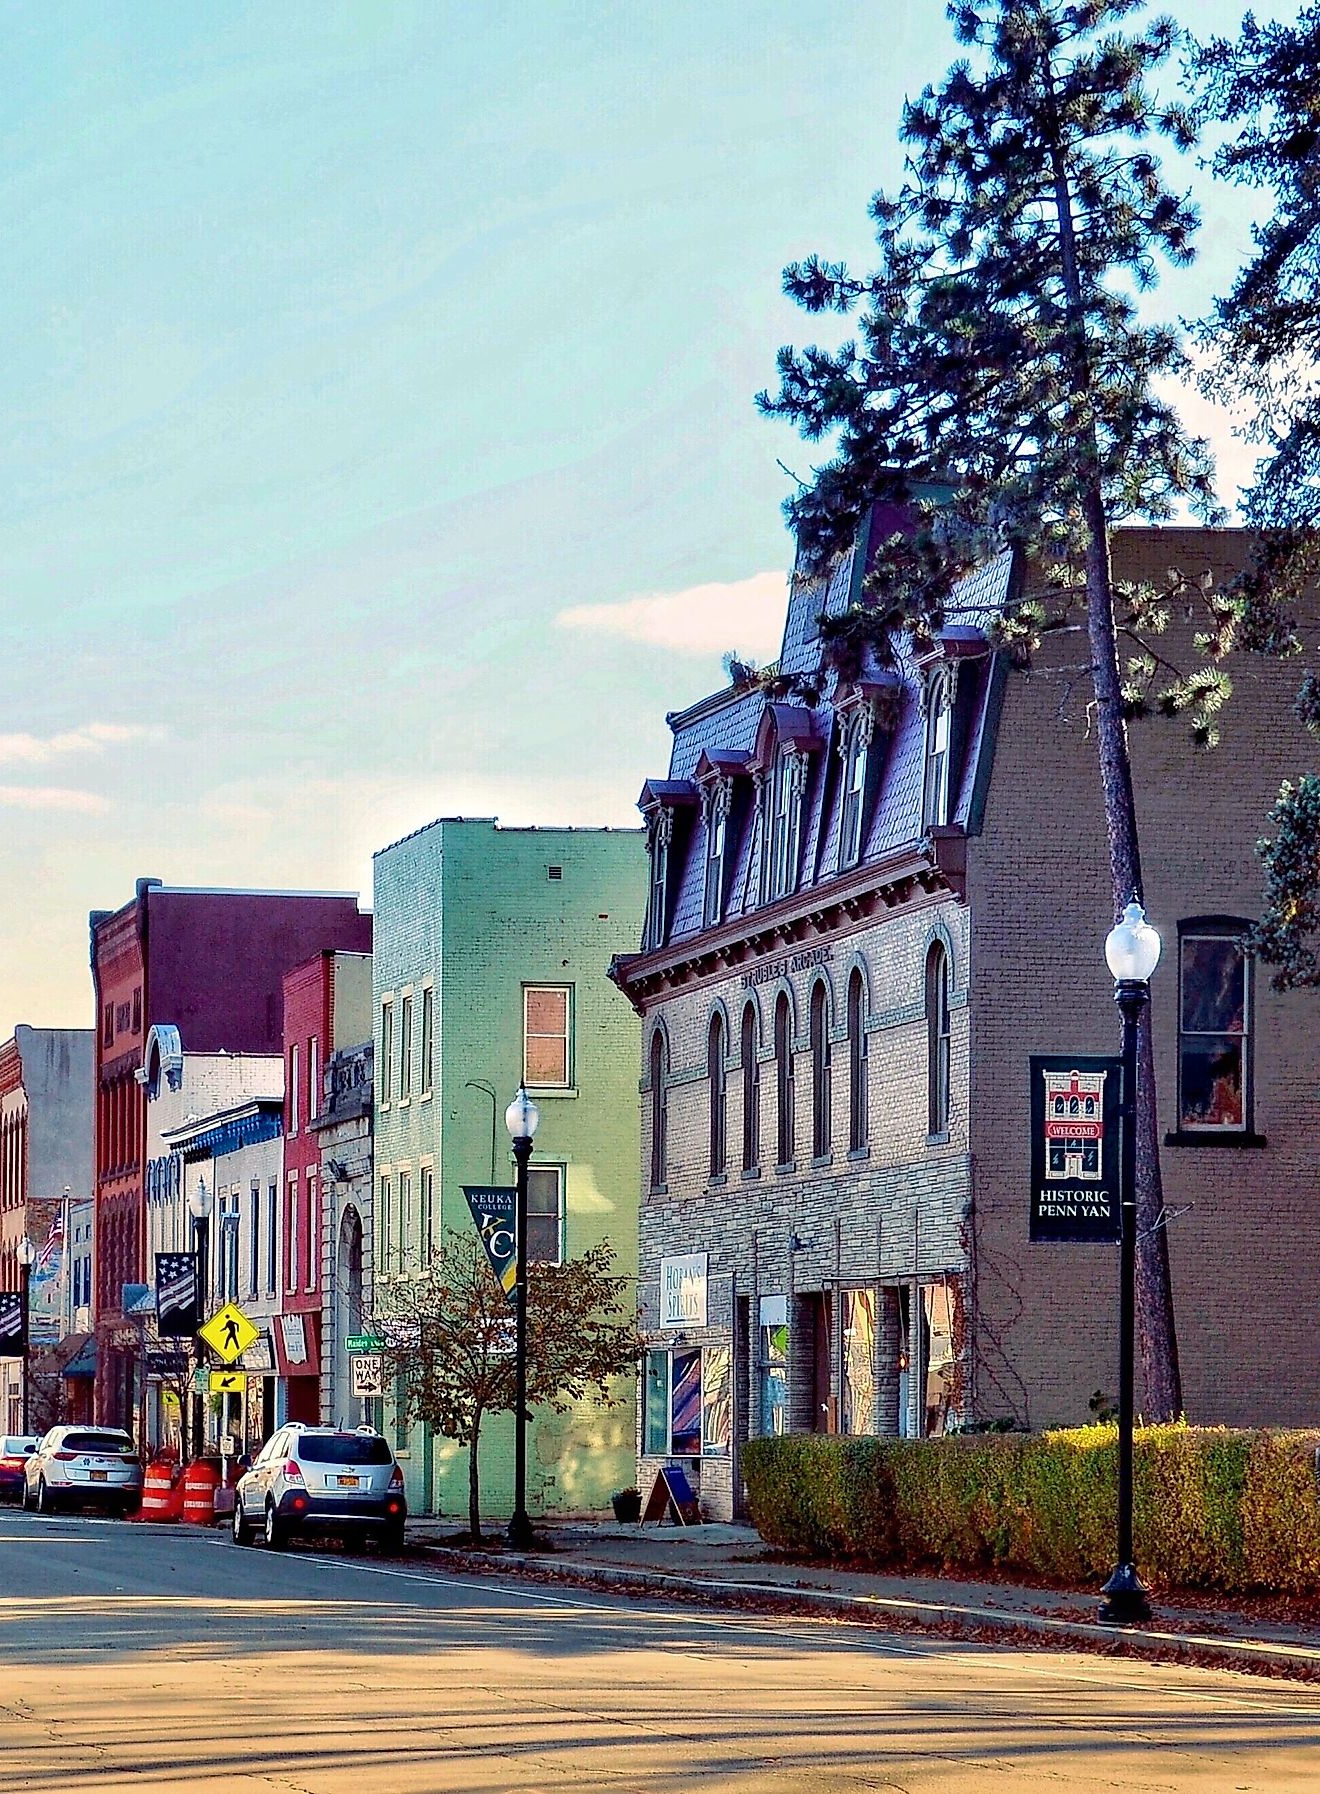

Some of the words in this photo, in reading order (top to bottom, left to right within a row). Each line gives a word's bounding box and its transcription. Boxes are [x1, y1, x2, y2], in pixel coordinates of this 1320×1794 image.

[1051, 1125, 1096, 1136] WELCOME
[471, 1194, 513, 1204] KEUKA
[1040, 1190, 1110, 1202] HISTORIC
[478, 1203, 513, 1211] COLLEGE
[1039, 1205, 1077, 1217] PENN
[1081, 1205, 1111, 1217] YAN
[668, 1291, 698, 1317] SPIRITS
[355, 1359, 379, 1370] ONE
[355, 1370, 380, 1380] WAY
